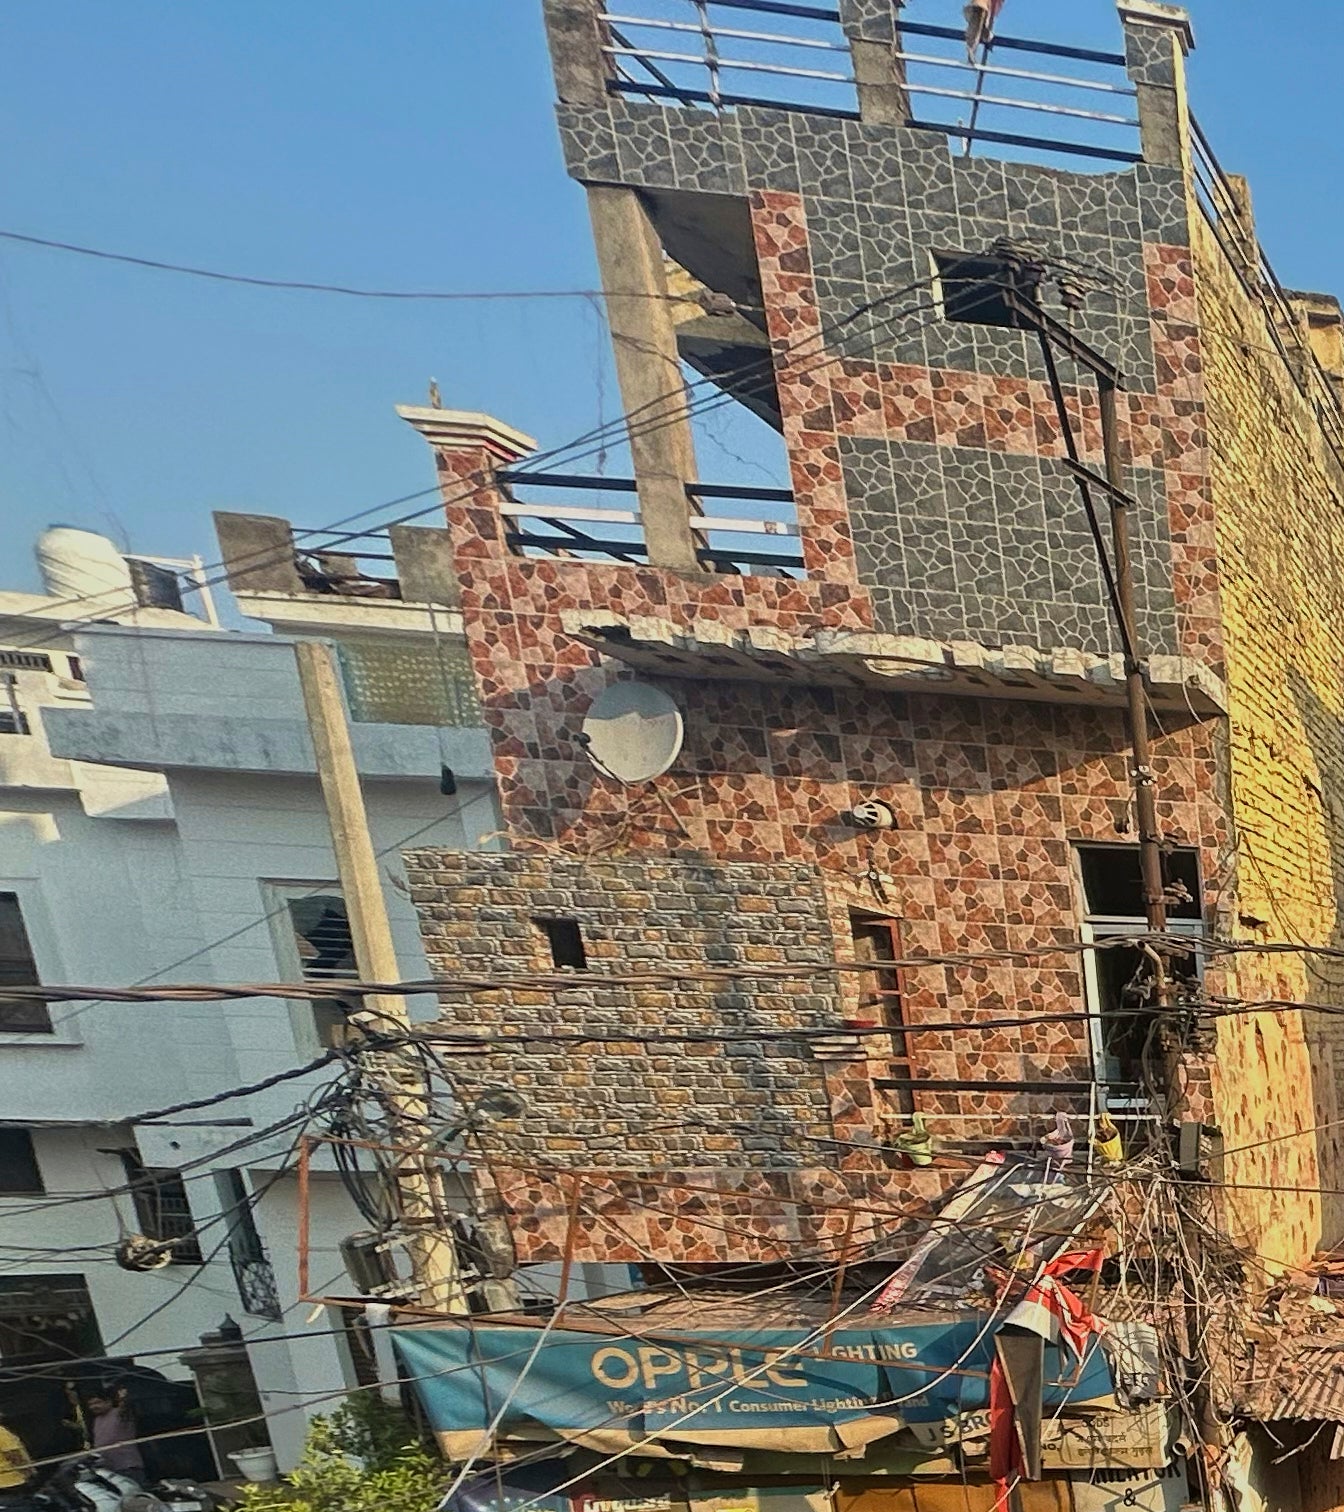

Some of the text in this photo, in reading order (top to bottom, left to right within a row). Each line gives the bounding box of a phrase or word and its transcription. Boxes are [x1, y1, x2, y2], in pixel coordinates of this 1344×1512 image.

[591, 1342, 918, 1389] OPPLE LGHTING
[729, 1399, 808, 1414] Consumer
[1124, 1488, 1136, 1507] &
